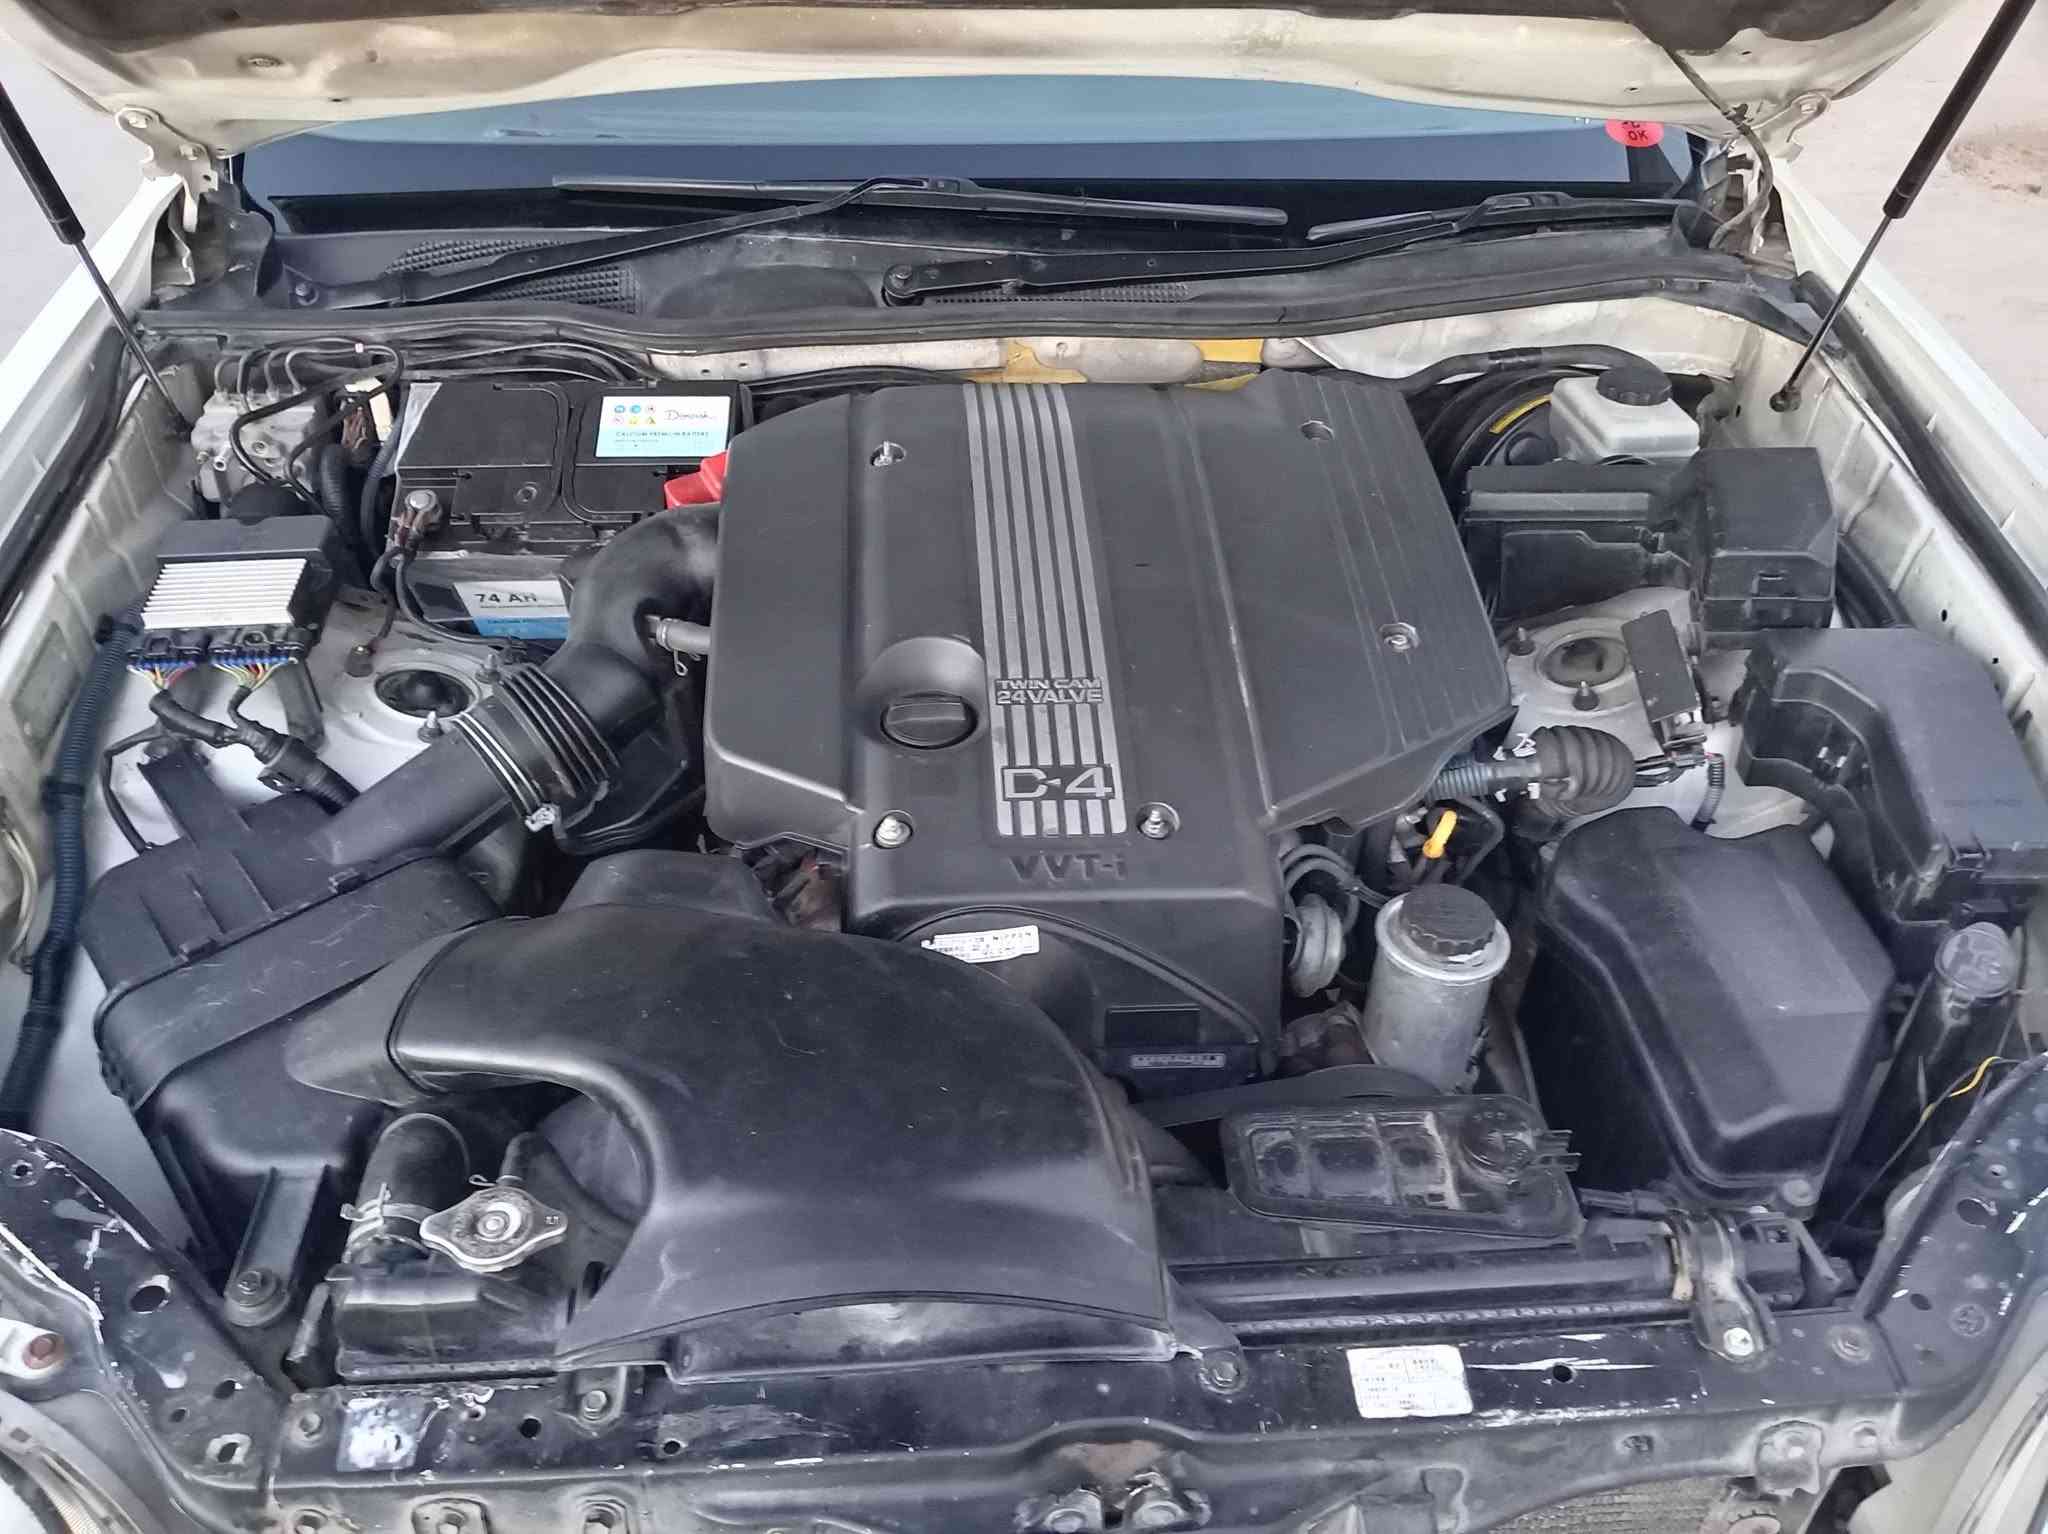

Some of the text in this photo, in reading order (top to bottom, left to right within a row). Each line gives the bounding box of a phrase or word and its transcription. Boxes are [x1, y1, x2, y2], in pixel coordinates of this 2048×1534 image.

[1628, 129, 1648, 141] OK
[473, 593, 500, 603] 74
[996, 679, 1101, 689] TWIN CAM
[996, 689, 1103, 705] 24VALVE
[1004, 767, 1113, 798] D-4
